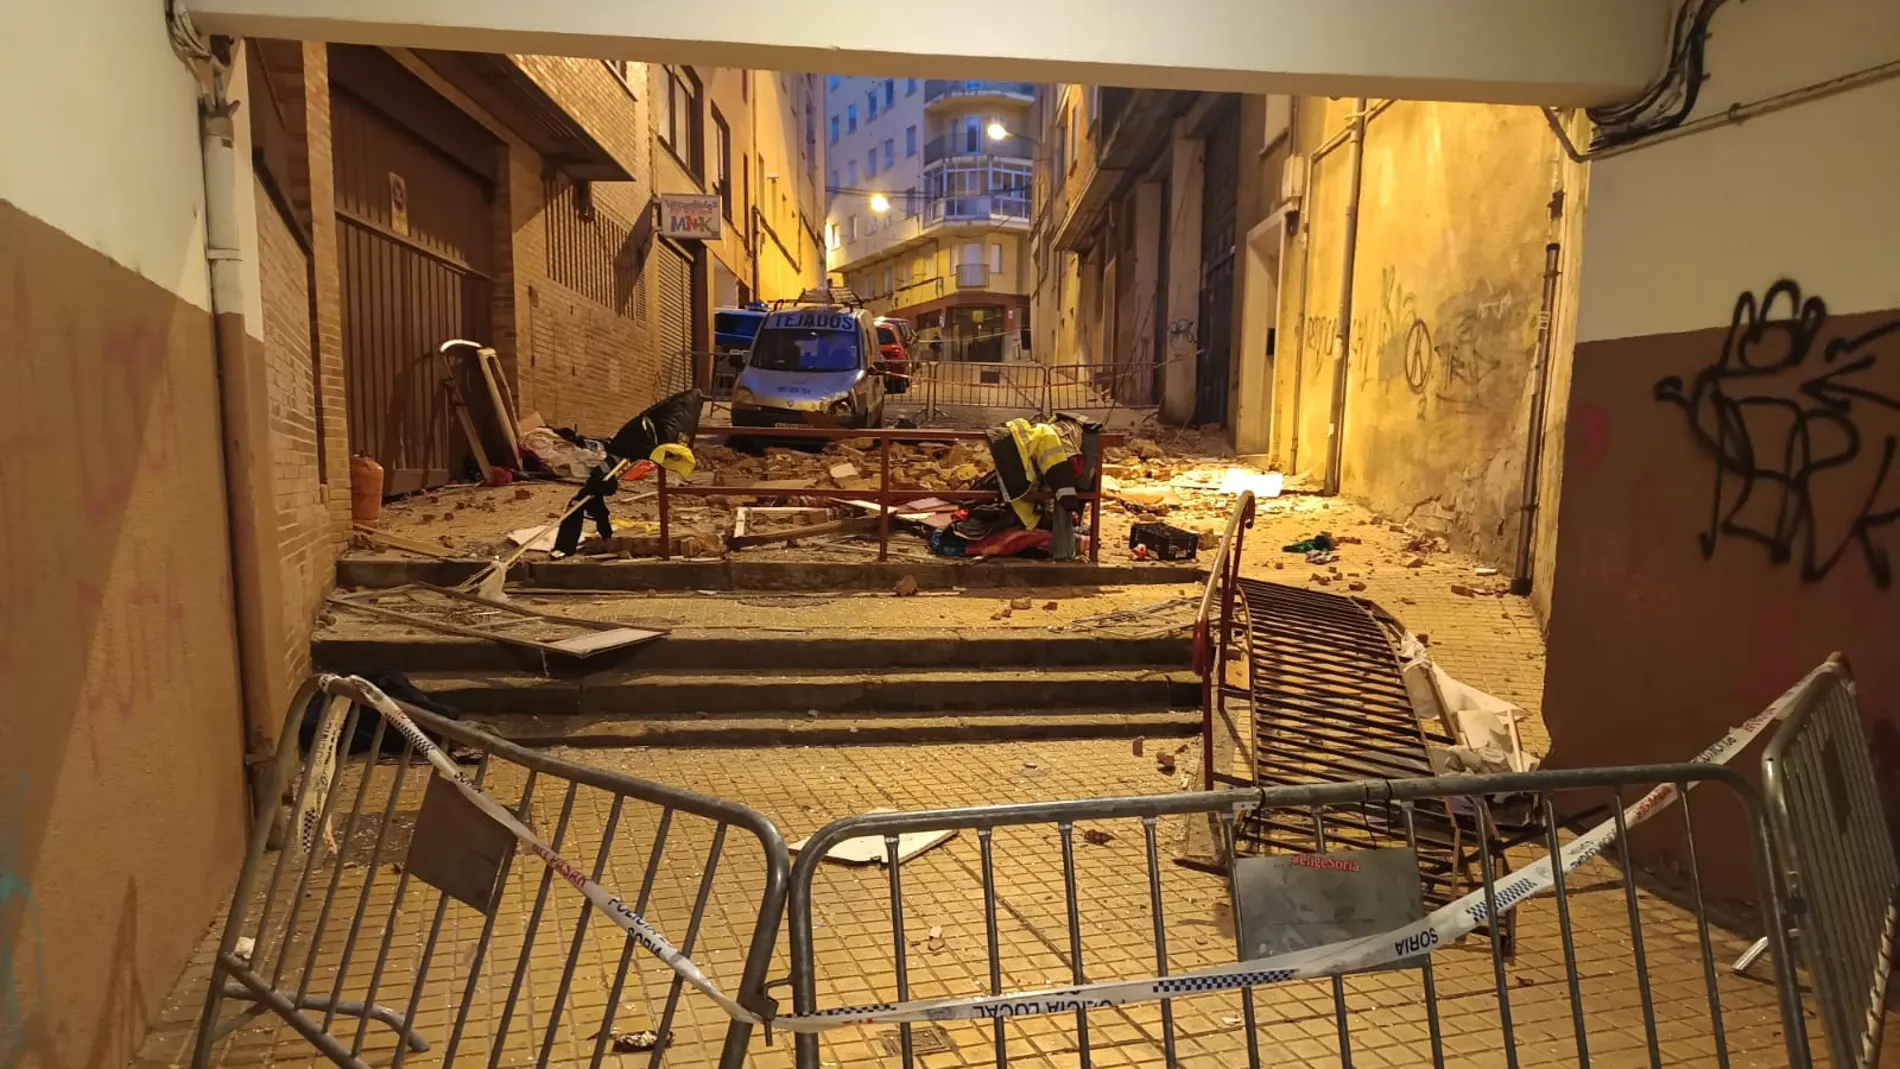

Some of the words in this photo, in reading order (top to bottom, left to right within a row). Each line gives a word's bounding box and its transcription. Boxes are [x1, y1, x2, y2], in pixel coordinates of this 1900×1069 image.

[776, 313, 854, 330] TEJADOS
[1394, 927, 1439, 956] SORIA
[972, 1002, 1040, 1018] LOCAL
